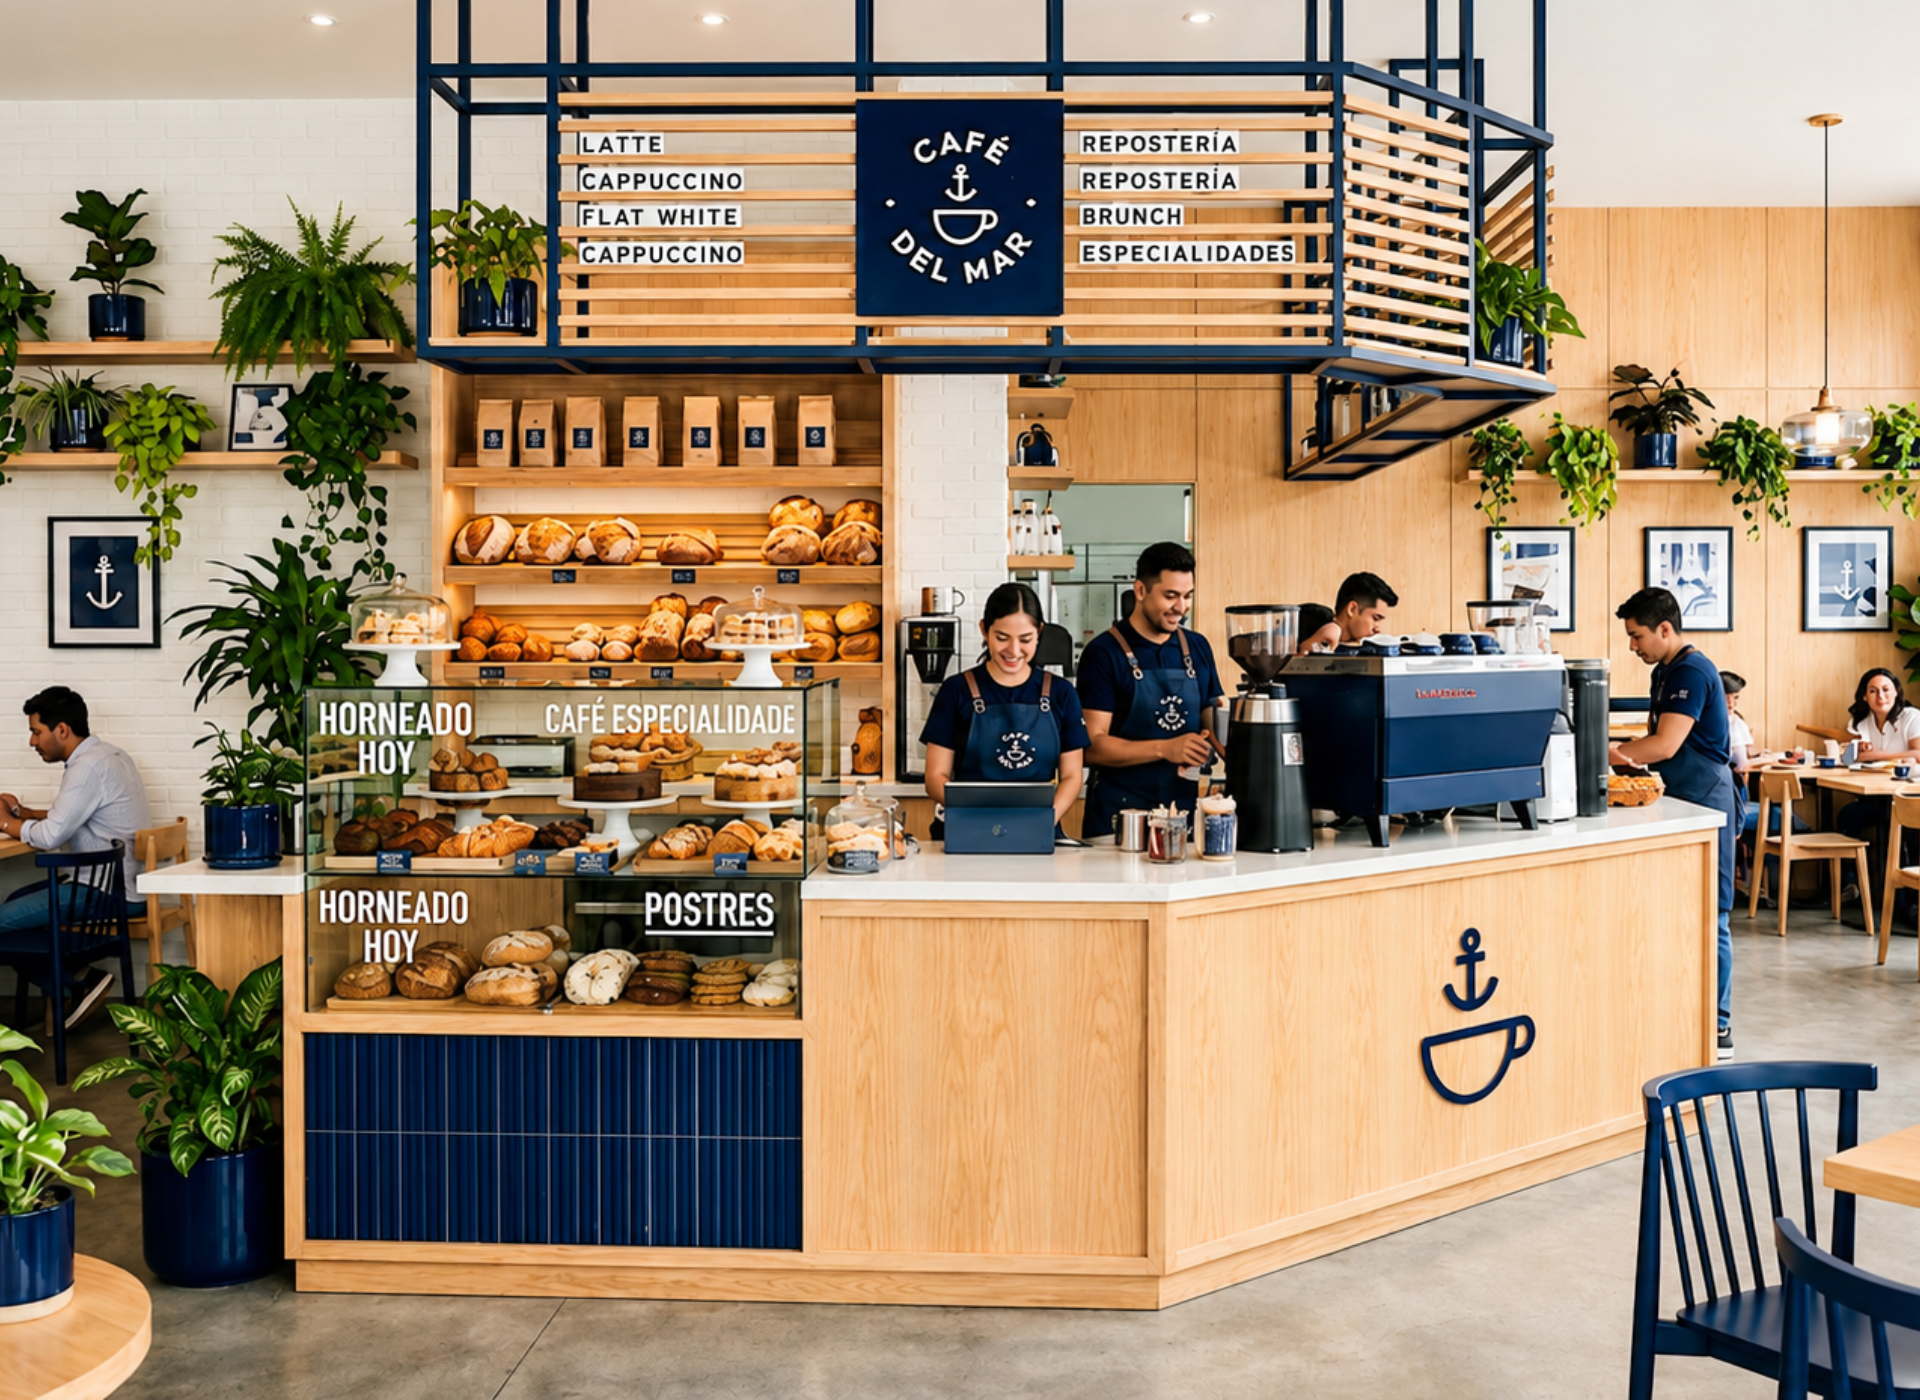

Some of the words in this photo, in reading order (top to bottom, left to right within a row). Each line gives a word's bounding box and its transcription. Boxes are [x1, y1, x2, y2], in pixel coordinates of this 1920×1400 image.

[583, 137, 660, 152] LATTE
[914, 131, 1010, 166] CAFÉ
[1084, 130, 1236, 152] REPOSTERÍA
[583, 173, 741, 190] CAPPUCCINO
[1084, 166, 1236, 188] REPOSTERÍA
[583, 209, 643, 225] FLAT
[658, 209, 737, 225] WHITE
[1084, 208, 1181, 224] BRUNCH
[583, 246, 741, 262] CAPPUCCINO
[891, 229, 948, 283] DEL
[963, 232, 1033, 284] MAR
[1084, 245, 1292, 261] ESPECIALIDADES
[319, 701, 472, 736] HORNEADO
[545, 696, 605, 734] CAFÉ
[613, 704, 795, 734] ESPECIALIDADE
[358, 740, 415, 775] HOY
[319, 890, 469, 924] HORNEADO
[644, 891, 775, 927] POSTRES
[364, 929, 419, 964] HOY
